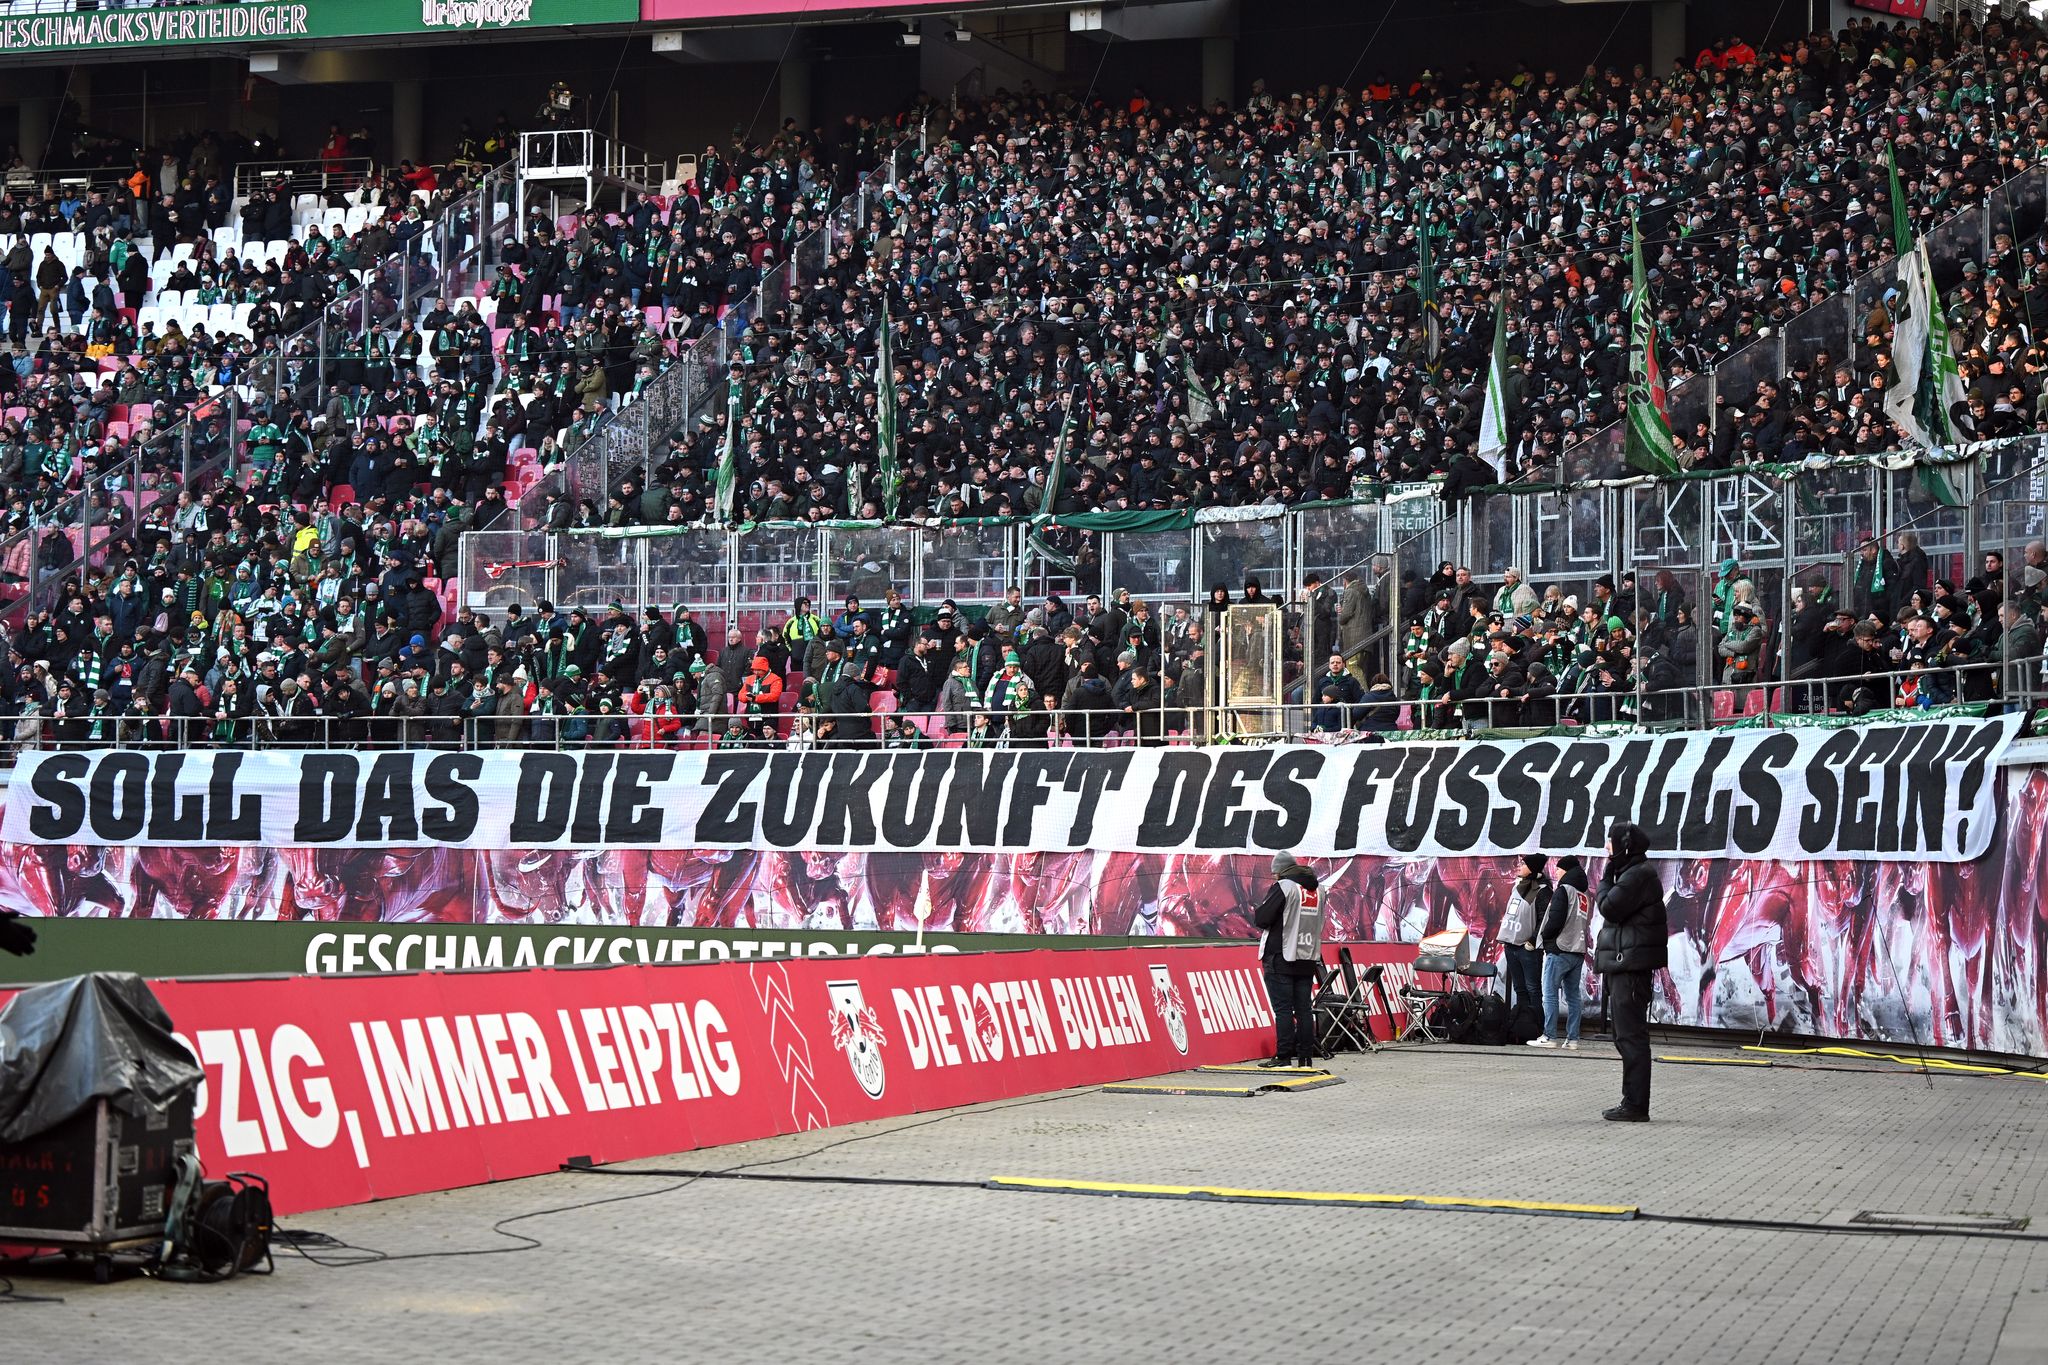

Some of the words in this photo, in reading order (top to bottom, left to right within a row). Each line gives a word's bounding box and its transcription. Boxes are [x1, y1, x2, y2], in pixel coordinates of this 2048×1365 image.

[30, 752, 262, 841] SOLL
[294, 753, 483, 843] DAS
[510, 753, 677, 843] DIE
[695, 750, 1135, 847] ZUKUNFT
[1136, 749, 1325, 849] DES
[1334, 732, 1799, 853] FUSSBALLS
[1798, 720, 2003, 855] SEIN?
[1297, 932, 1312, 945] 10
[891, 985, 963, 1070] DIE
[951, 979, 1055, 1062] ROTEN
[1052, 974, 1151, 1051] BULLEN
[1186, 970, 1271, 1034] EINMAL
[350, 1011, 571, 1138] IMMER
[557, 999, 741, 1111] LEIPZIG
